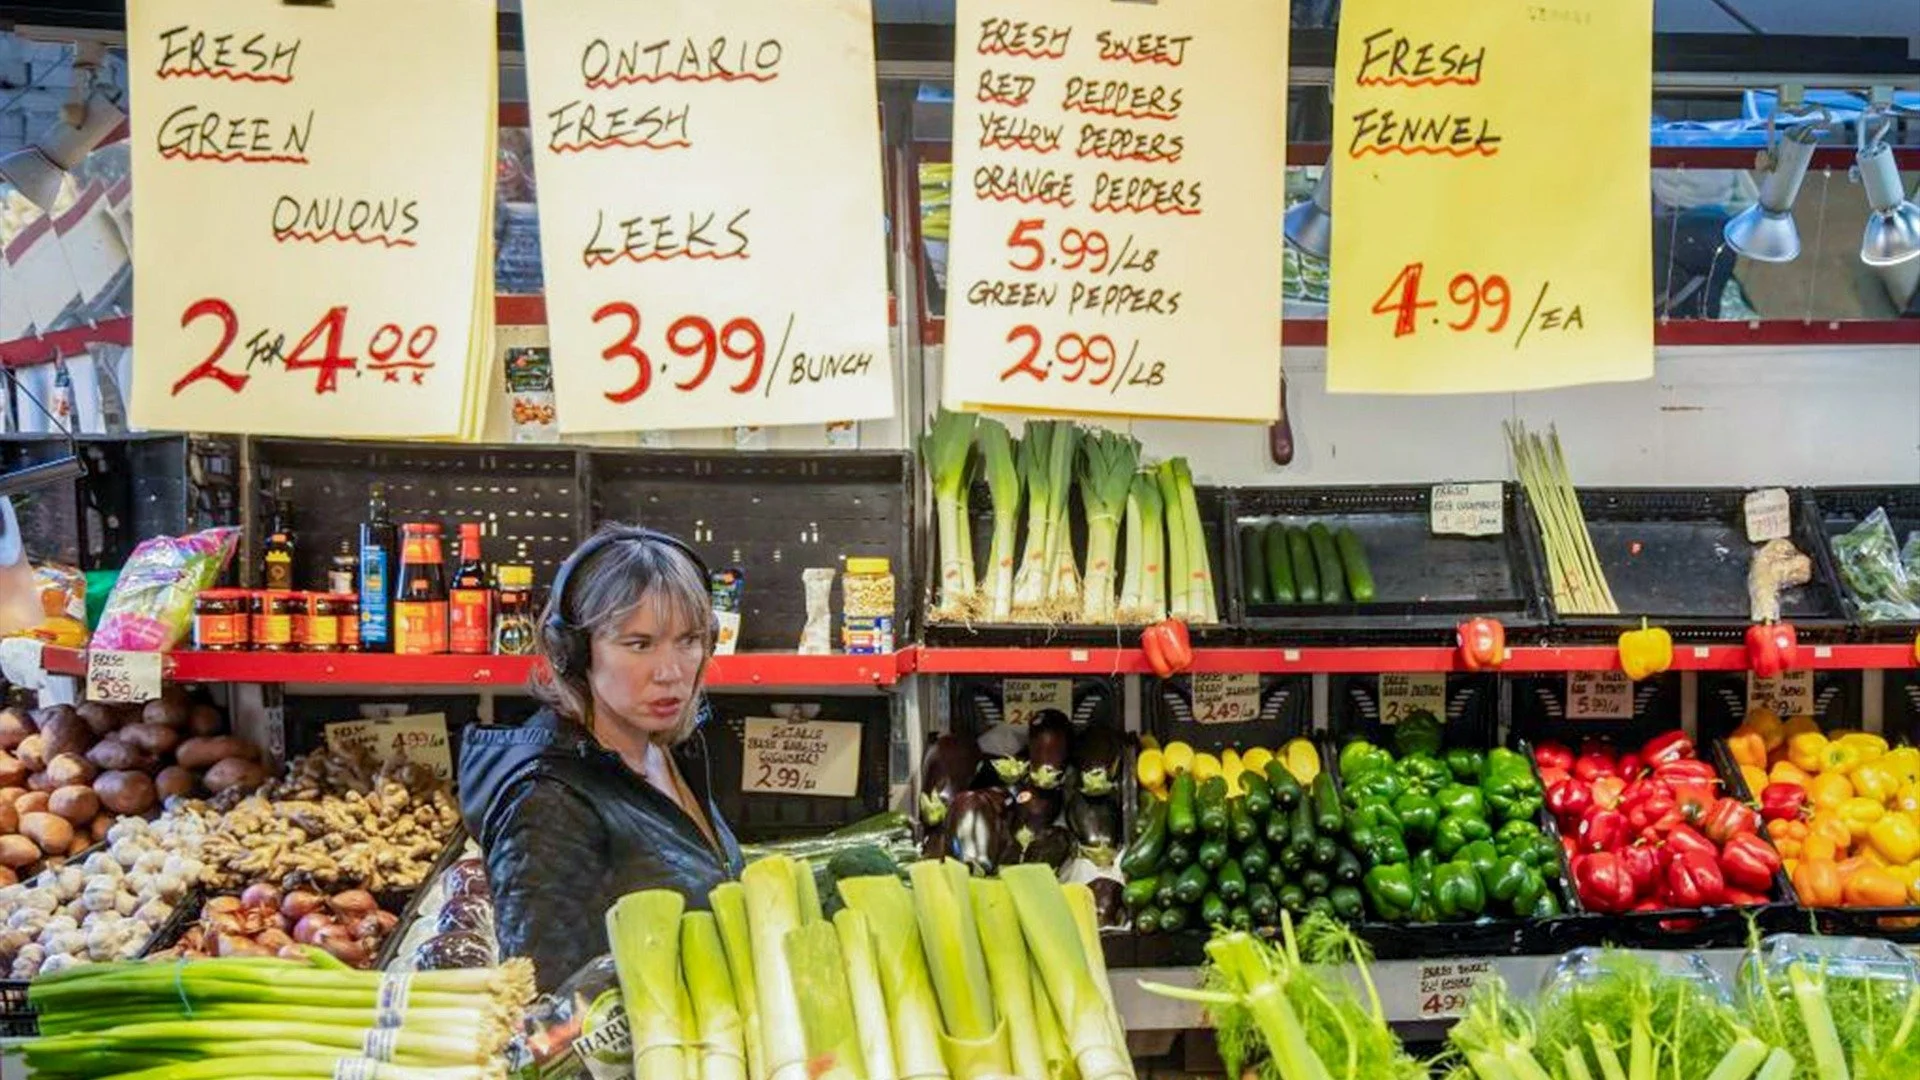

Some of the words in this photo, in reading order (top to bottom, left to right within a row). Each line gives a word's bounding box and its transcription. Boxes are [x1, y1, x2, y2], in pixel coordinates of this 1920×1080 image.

[159, 26, 300, 74] FRESH
[582, 37, 782, 80] ONTARIO
[978, 18, 1072, 55] FRESH
[1096, 31, 1193, 64] SWEET
[1357, 29, 1485, 85] FRESH
[978, 70, 1035, 100] RED
[1064, 77, 1184, 112] PEPPERS
[157, 105, 314, 153] GREEN
[548, 101, 689, 142] FRESH
[979, 112, 1064, 148] YELLOW
[1078, 124, 1184, 156] PEPPERS
[1349, 109, 1501, 154] FENNEL
[974, 166, 1074, 200] ORANGE
[1093, 173, 1201, 208] PEPPERS
[272, 196, 419, 235] ONIONS
[585, 209, 750, 255] LEEKS
[967, 281, 1057, 307] GREEN
[1069, 284, 1182, 315] PEPPERS
[171, 298, 250, 397] 2
